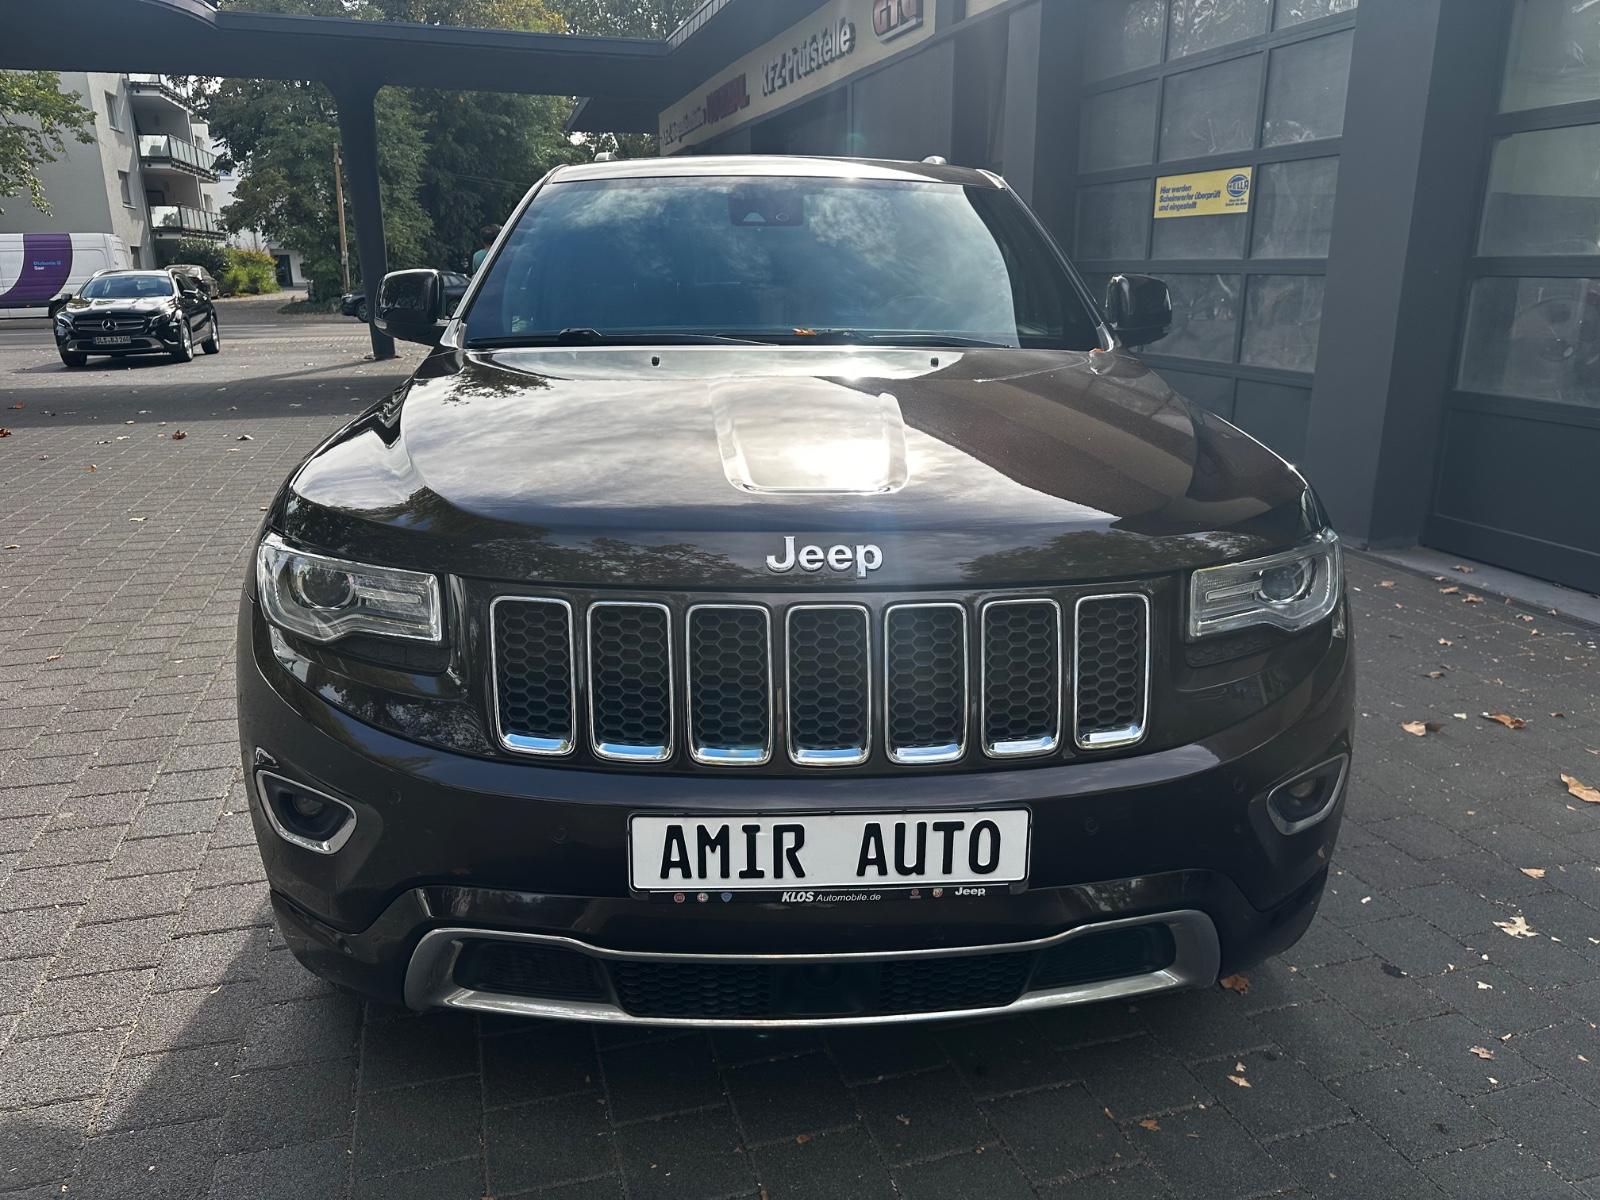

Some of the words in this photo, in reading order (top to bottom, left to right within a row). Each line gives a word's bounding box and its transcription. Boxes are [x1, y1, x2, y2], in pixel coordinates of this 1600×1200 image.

[1160, 186, 1171, 194] Hier
[1171, 184, 1192, 193] werden
[1159, 193, 1194, 203] Scheinwerfer
[1194, 190, 1221, 201] überprüft
[1159, 203, 1169, 211] und
[1169, 201, 1197, 212] eingestellt
[766, 536, 883, 578] Jeep
[660, 823, 806, 879] AMIR
[857, 818, 1002, 877] AUTO
[781, 891, 815, 903] KLOS
[815, 893, 882, 903] Automobile.de
[954, 886, 986, 897] Jeep
